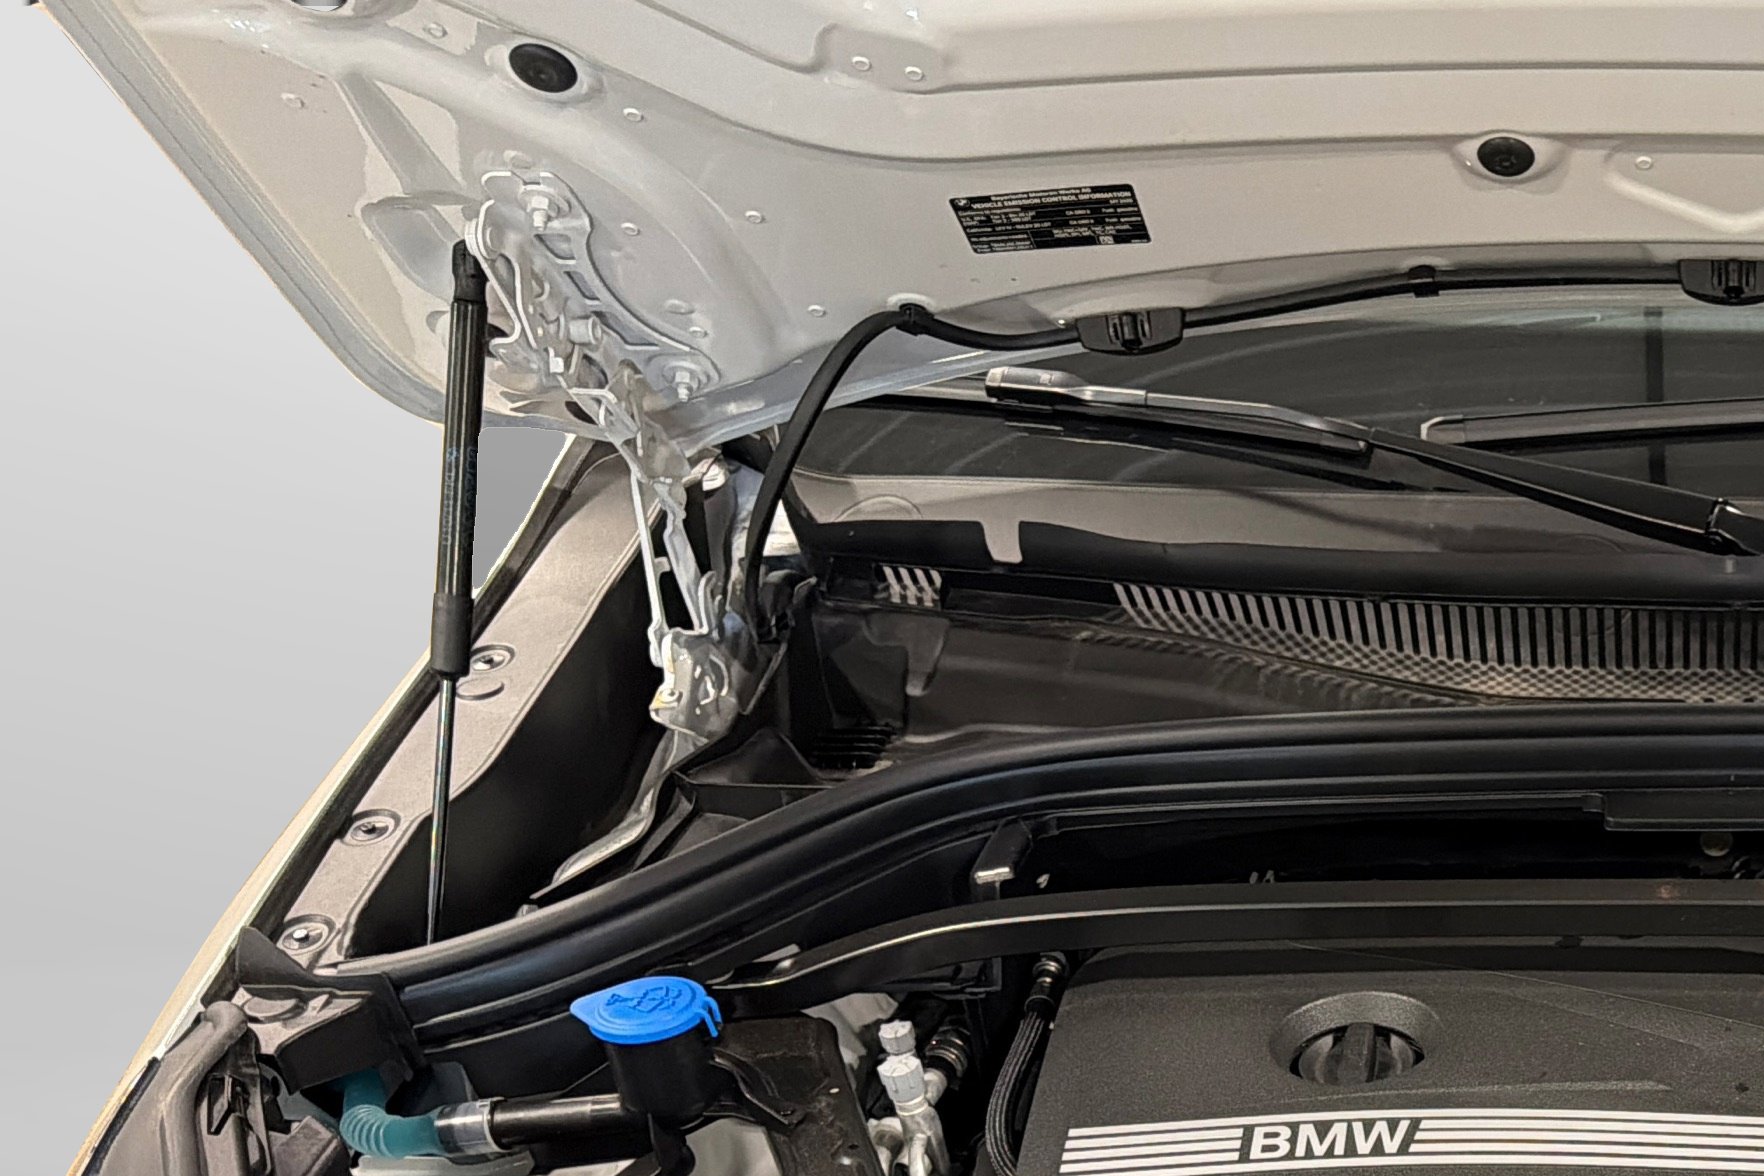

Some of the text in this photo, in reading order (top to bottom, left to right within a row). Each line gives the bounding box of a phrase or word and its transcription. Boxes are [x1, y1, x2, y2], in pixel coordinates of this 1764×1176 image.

[970, 190, 1131, 210] VEHICLE EMISSION CONTROL INFORMATION
[1249, 1119, 1411, 1160] BMW
